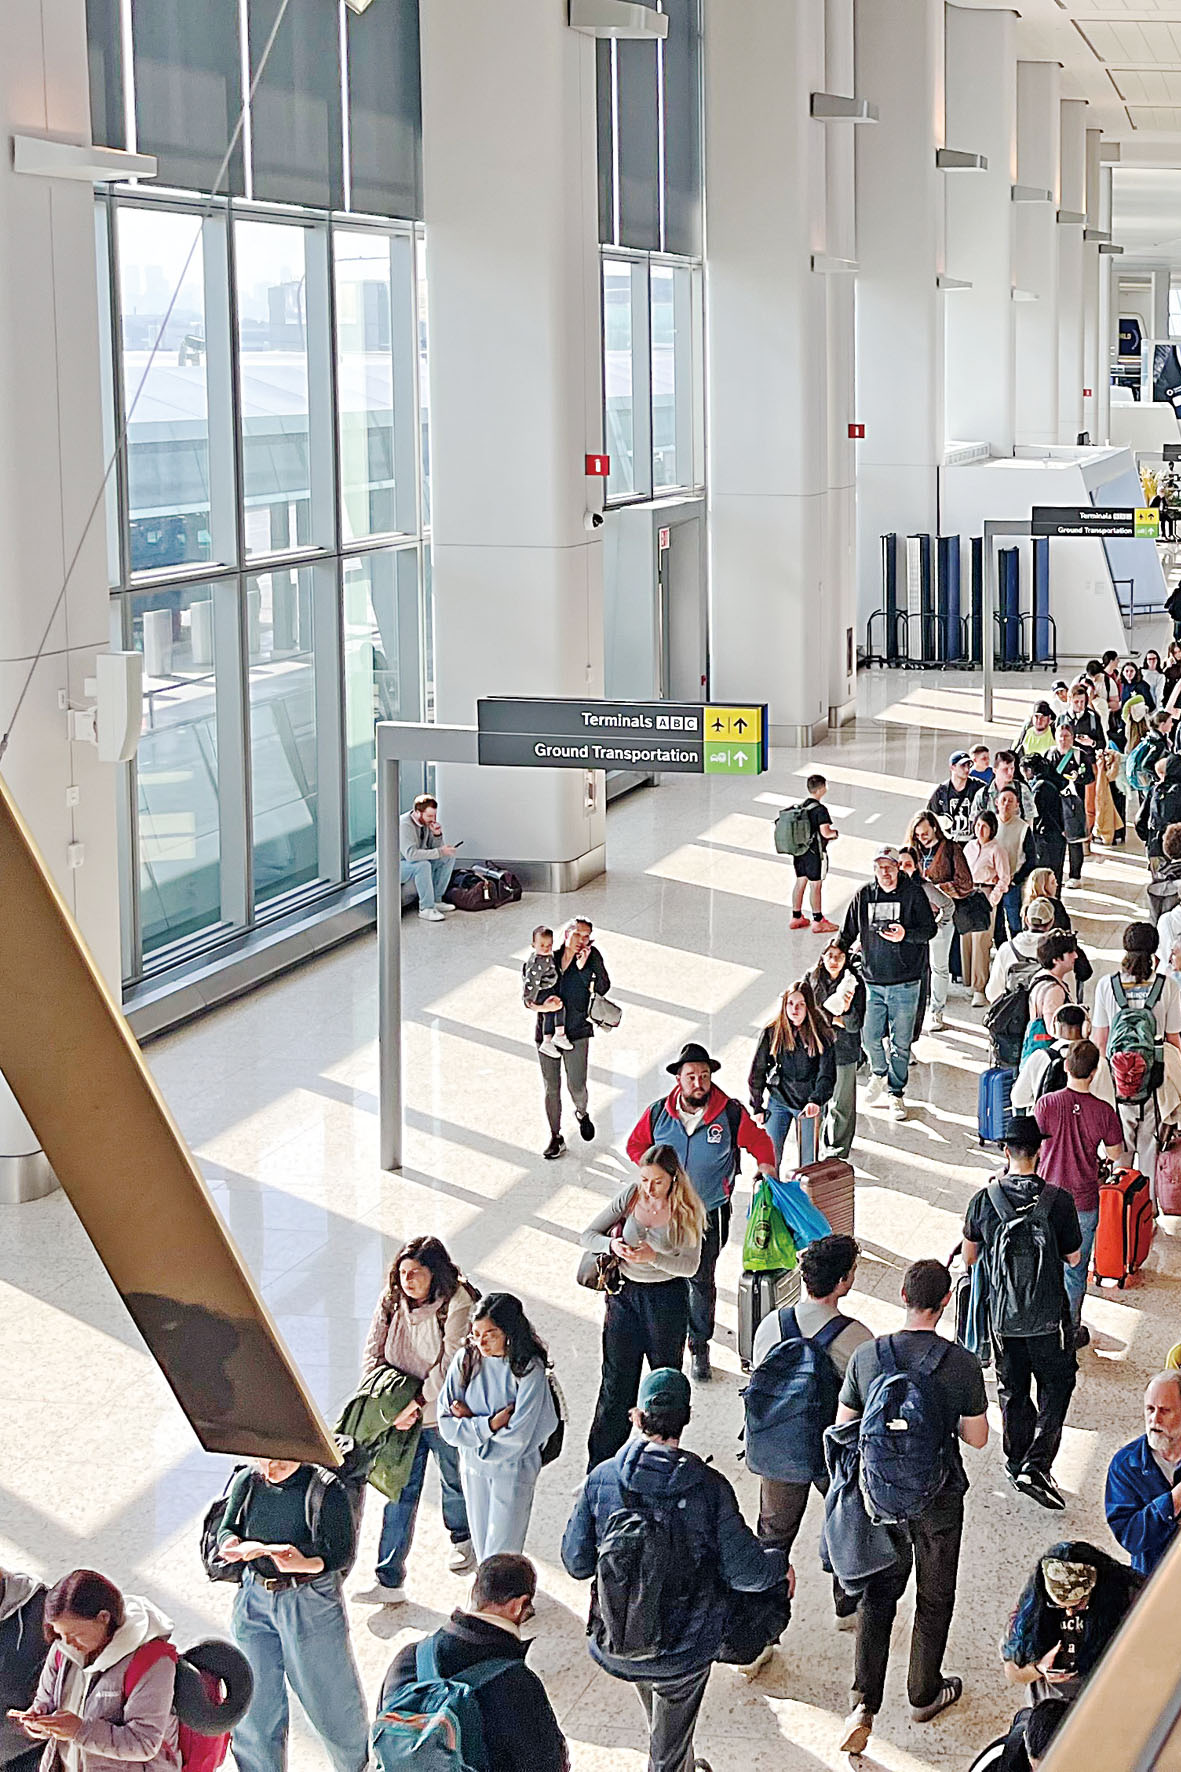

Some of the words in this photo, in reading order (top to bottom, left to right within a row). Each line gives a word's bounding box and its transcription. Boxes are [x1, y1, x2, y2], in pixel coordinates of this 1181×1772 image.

[581, 712, 653, 729] Terminals
[534, 742, 589, 758] Ground
[592, 745, 699, 763] Transportation
